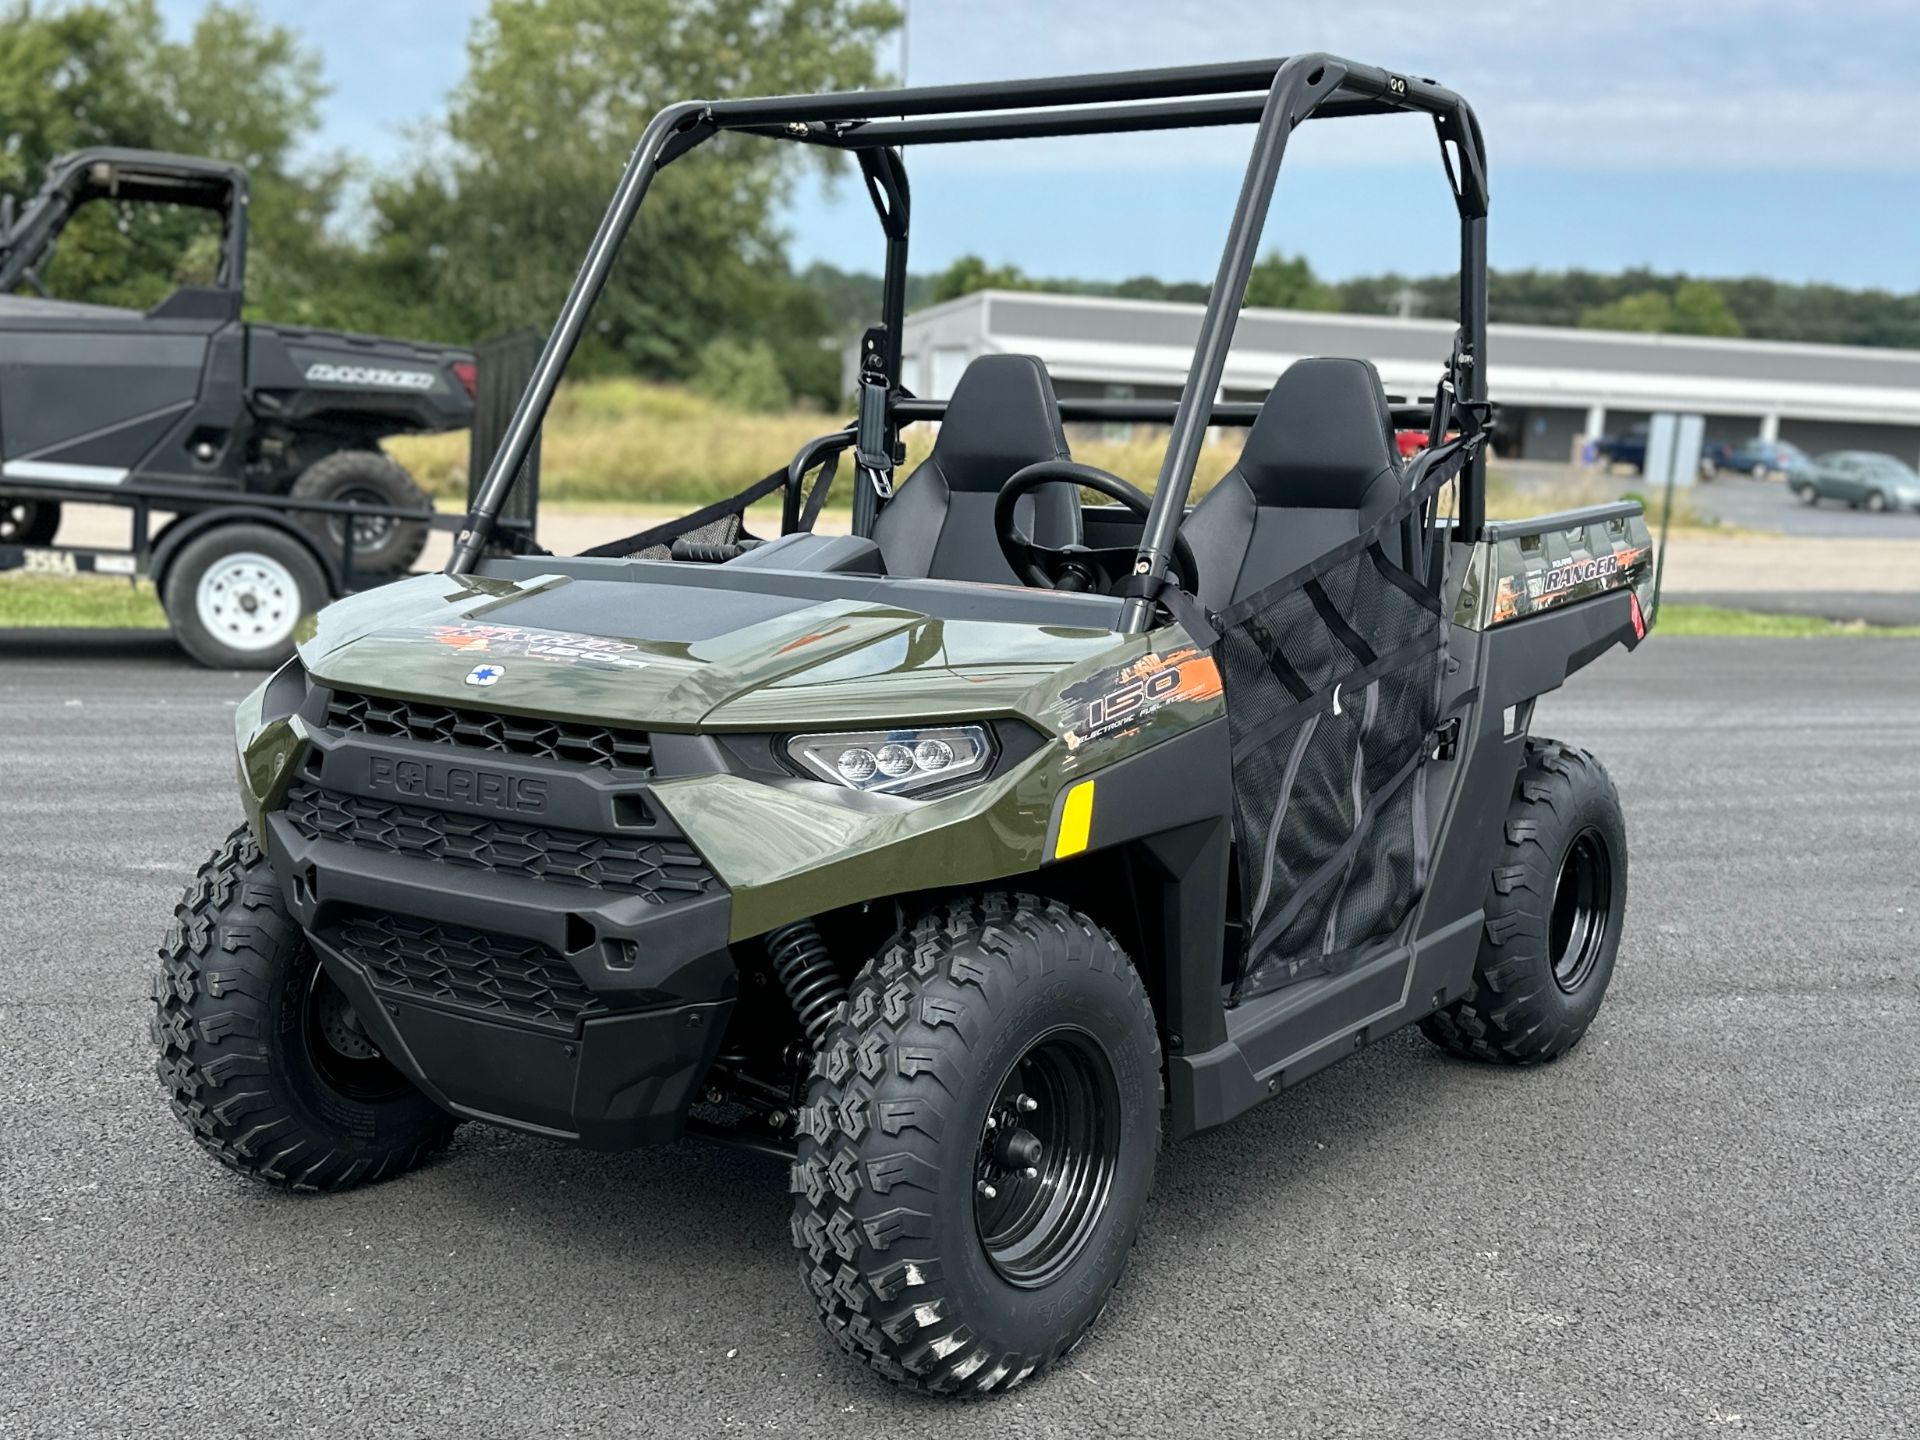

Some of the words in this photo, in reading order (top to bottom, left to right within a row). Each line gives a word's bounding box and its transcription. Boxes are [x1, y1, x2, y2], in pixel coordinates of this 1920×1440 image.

[1544, 555, 1618, 592] RANGER
[529, 645, 621, 662] 150
[1089, 666, 1182, 727] 150
[1079, 714, 1136, 743] ELECTRONIC
[1139, 703, 1163, 717] FUEL
[369, 756, 549, 815] POLARIS
